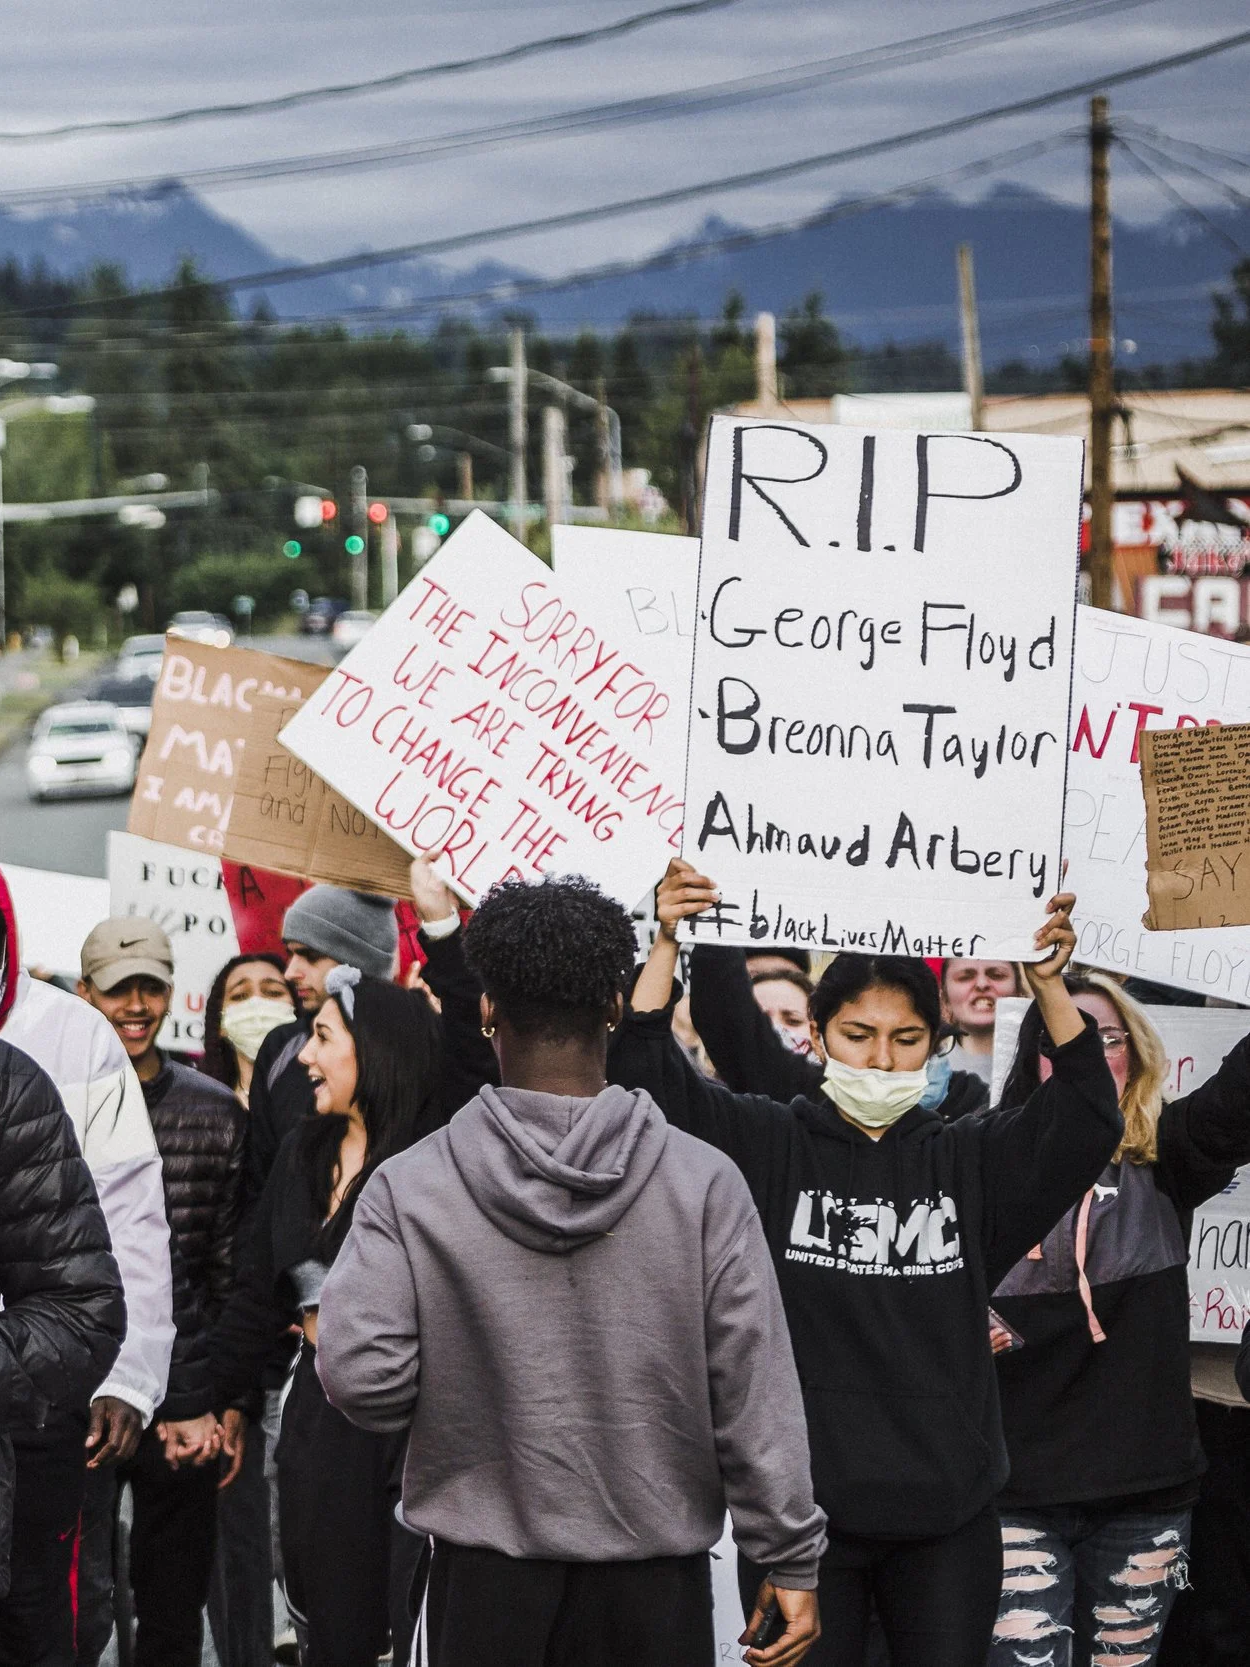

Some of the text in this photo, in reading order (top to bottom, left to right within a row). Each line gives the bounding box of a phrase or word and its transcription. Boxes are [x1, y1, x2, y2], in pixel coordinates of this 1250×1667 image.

[409, 576, 477, 648] THE
[709, 576, 1055, 682] George Floyd
[500, 582, 671, 746] SORRY FOR
[160, 724, 246, 777] MA
[321, 669, 569, 874] TO CHANGE THE
[393, 643, 625, 842] WE ARE TRYING
[717, 677, 1056, 779] Breonna Taylor
[260, 792, 308, 825] and
[330, 802, 379, 840] NO
[697, 791, 1046, 898] Ahmaud Arbery
[1172, 851, 1243, 901] SAY
[1170, 940, 1250, 999] FLOY
[785, 1248, 836, 1268] UNITED
[836, 1258, 883, 1276] STATES
